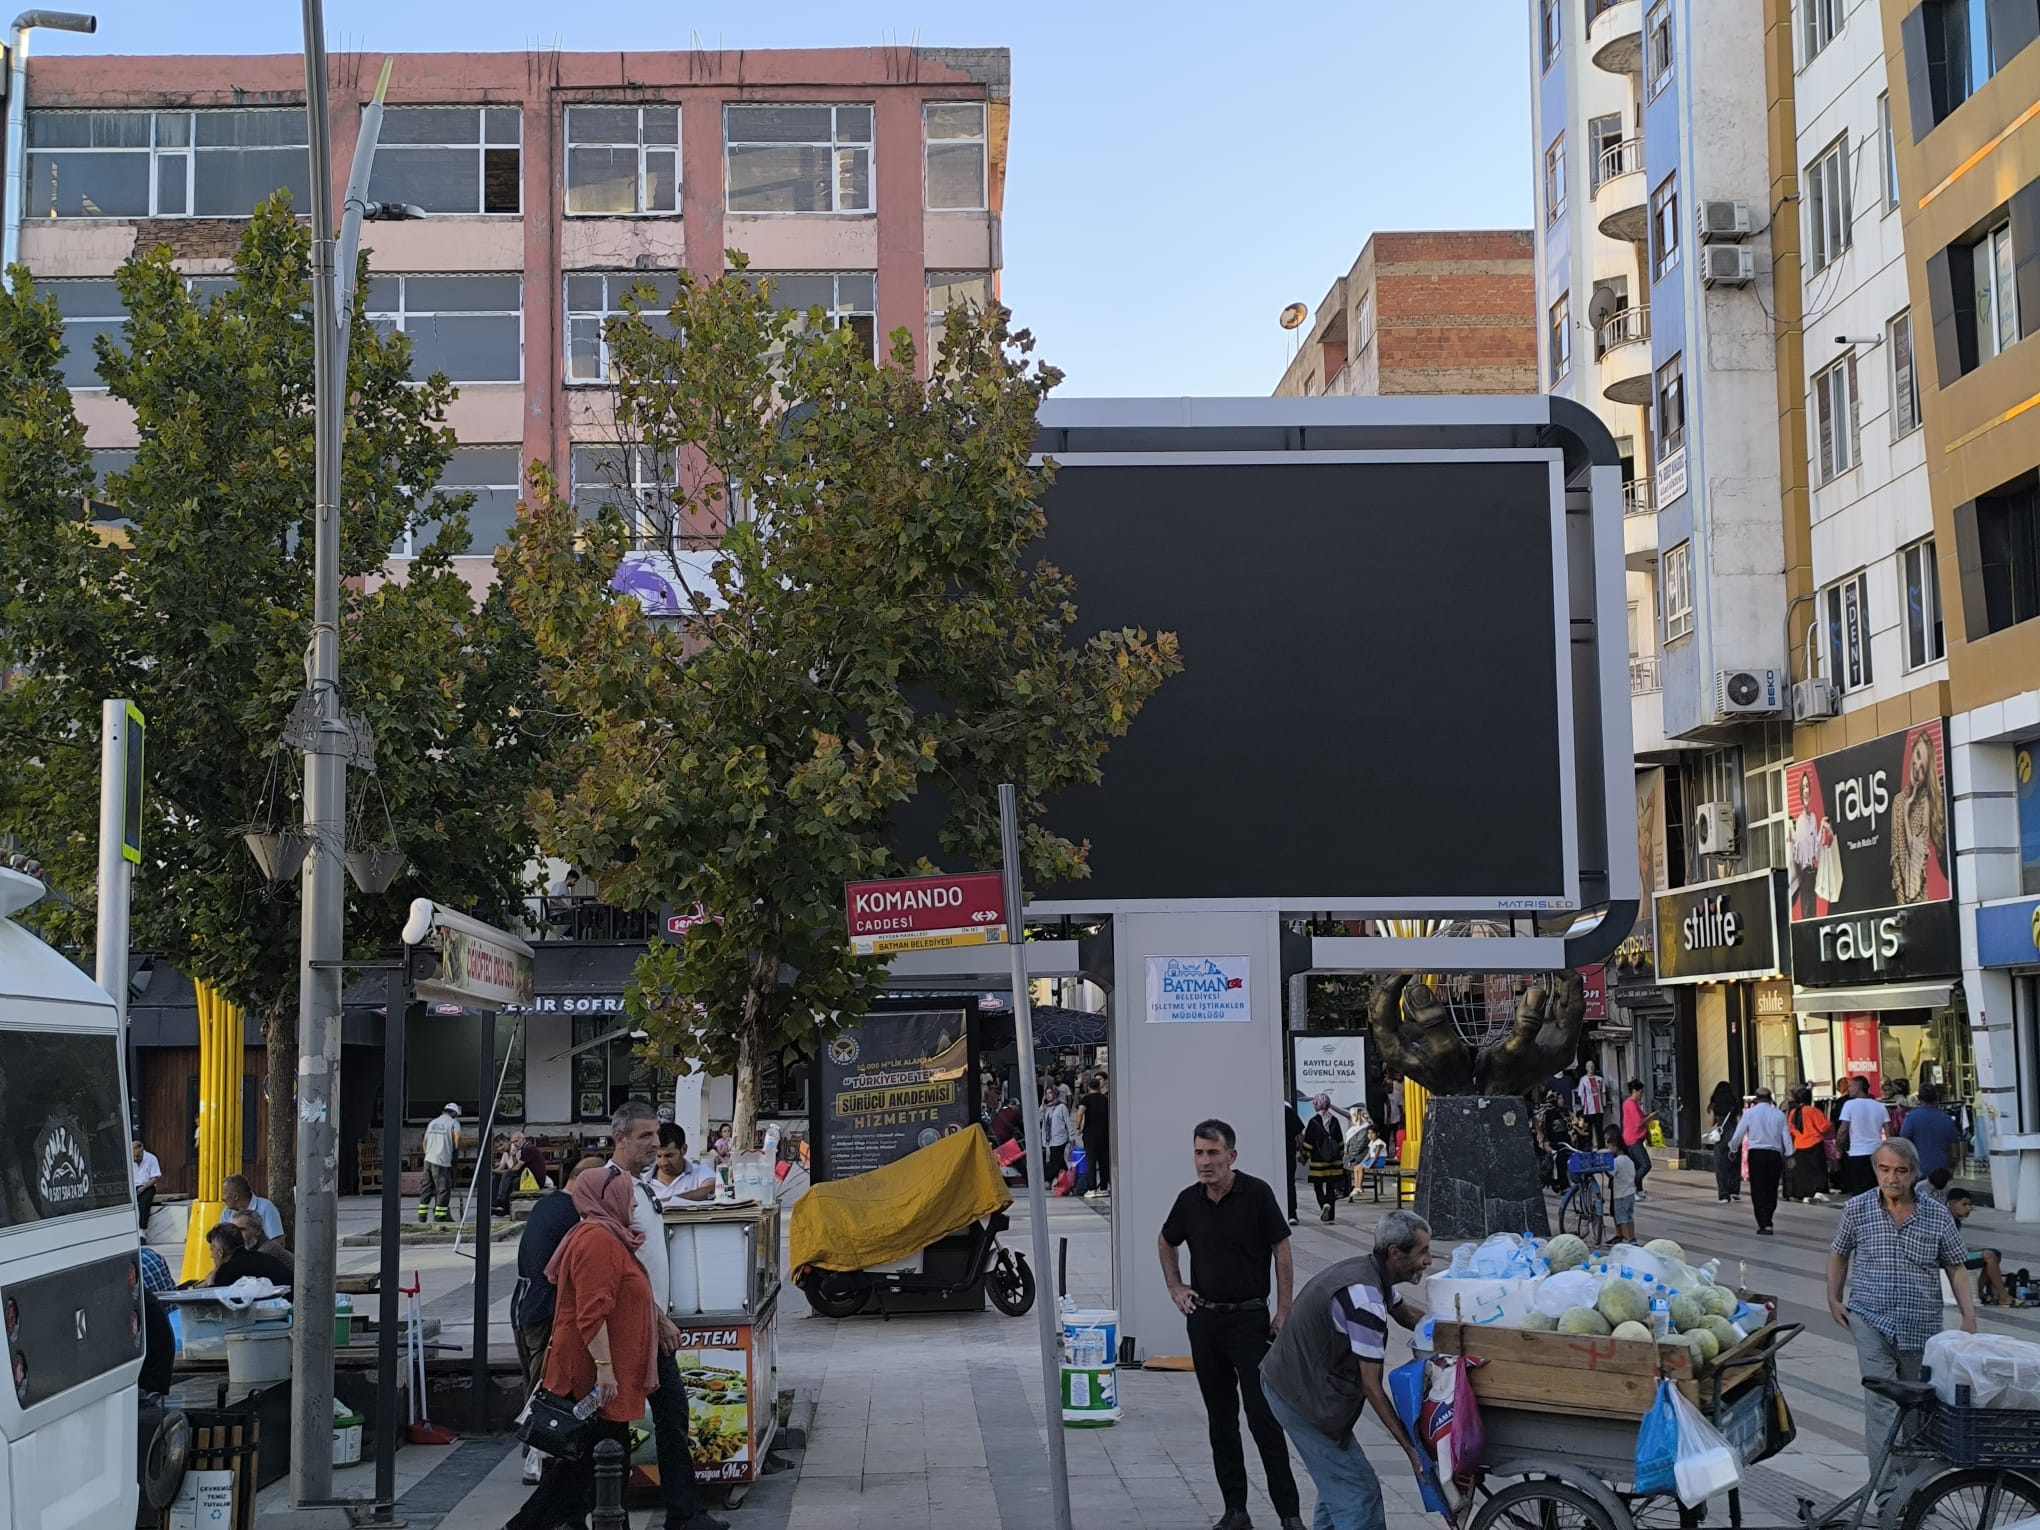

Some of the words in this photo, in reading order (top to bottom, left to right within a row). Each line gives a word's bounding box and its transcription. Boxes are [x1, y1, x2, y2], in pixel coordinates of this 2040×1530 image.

[1766, 670, 1776, 706] BEKO
[1834, 770, 1889, 831] rays
[855, 886, 963, 913] KOMANDO
[1498, 900, 1574, 909] MATRISLED
[856, 915, 913, 932] CADDESİ
[1683, 895, 1738, 951] stilife
[878, 942, 909, 951] BATMAN
[910, 937, 953, 948] BELEDİYESİ
[1819, 917, 1899, 972] rays
[1163, 977, 1229, 993] BATMAN
[1175, 992, 1220, 1001] BELEDİYESİ
[1757, 989, 1784, 1012] stilife
[1151, 1002, 1185, 1012] İŞLETME
[1187, 1002, 1198, 1010] VE
[1199, 1001, 1245, 1011] İŞTİRAKLER
[1171, 1011, 1225, 1019] MÜDÜRLÜĞÜ
[1303, 1059, 1332, 1067] KAYITLI
[1333, 1059, 1355, 1068] ÇALIŞ
[1847, 1057, 1878, 1072] İNDİRİM
[1302, 1068, 1335, 1076] GÜVENLİ
[1336, 1069, 1356, 1077] YAŞA
[842, 1091, 886, 1113] SÜRÜCÜ
[889, 1084, 951, 1107] AKADEMİSİ
[854, 1108, 939, 1129] HİZMETTE
[680, 1329, 738, 1347] ÖFTEM
